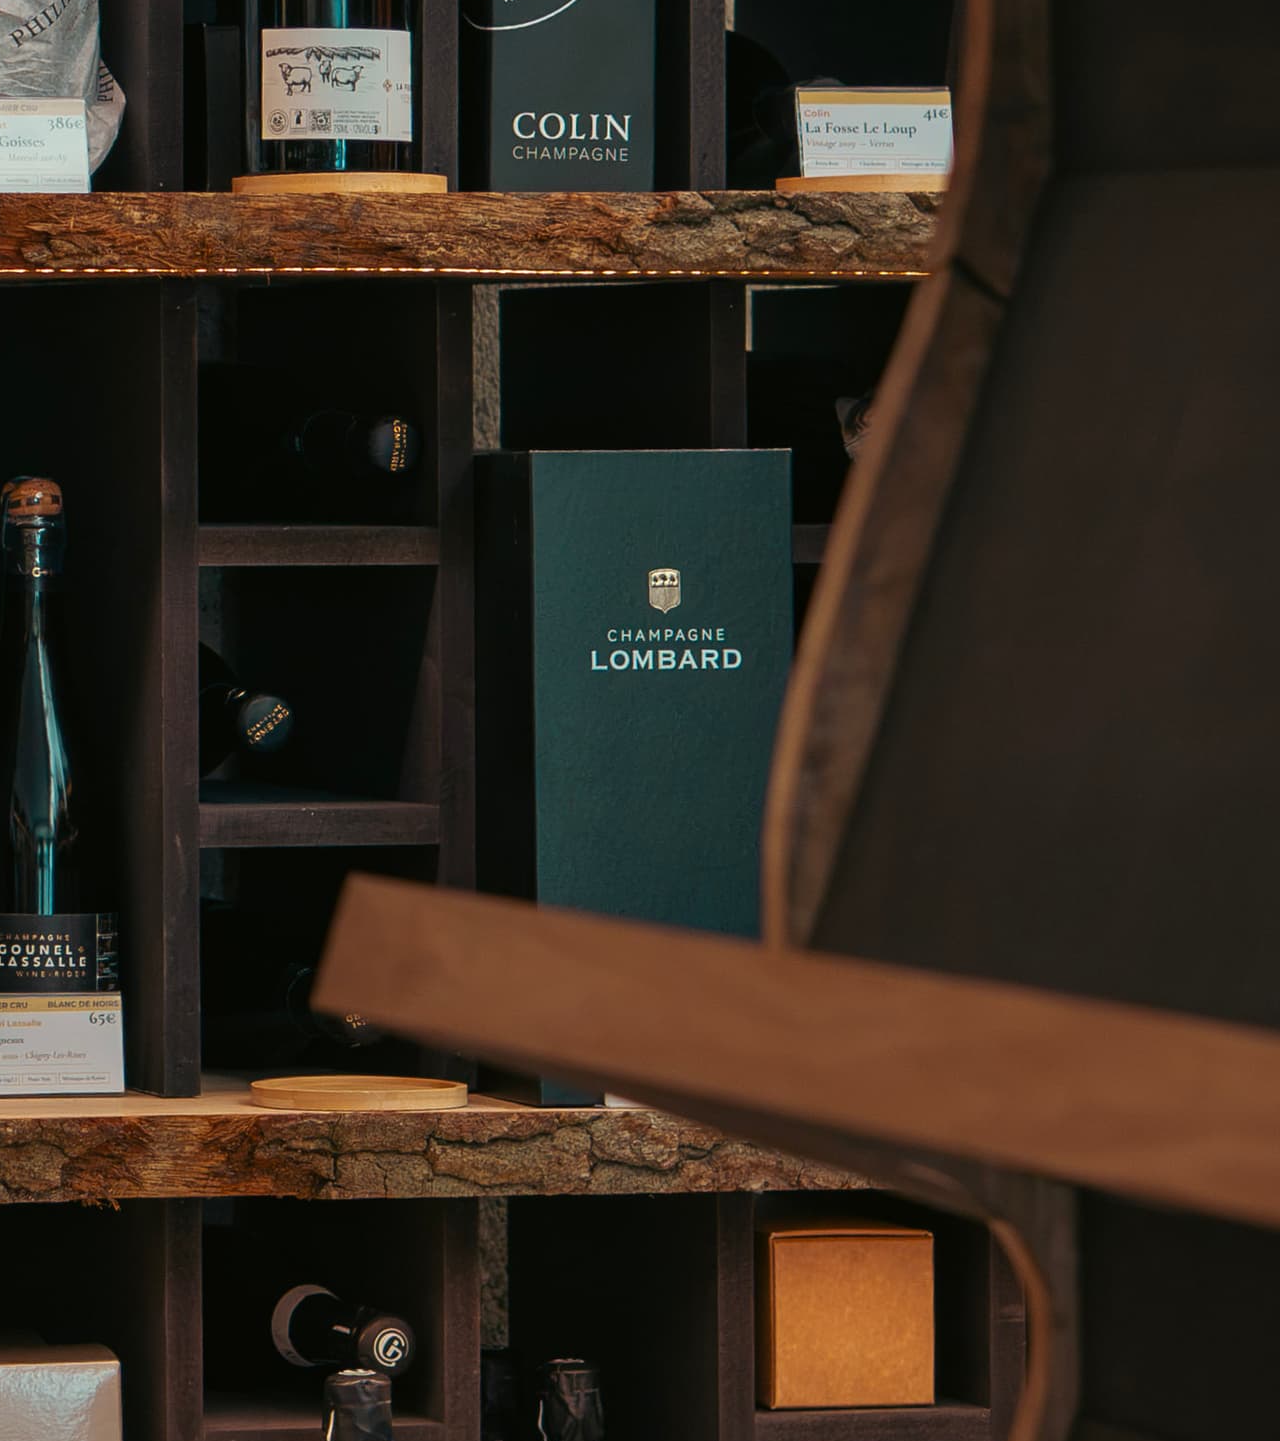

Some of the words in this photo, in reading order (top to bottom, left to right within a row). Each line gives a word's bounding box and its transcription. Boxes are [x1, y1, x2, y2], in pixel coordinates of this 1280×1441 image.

[512, 112, 631, 141] COLIN
[806, 122, 820, 133] La
[825, 122, 859, 133] Fosse
[883, 122, 917, 137] Loup
[512, 146, 628, 162] CHAMPAGNE
[607, 629, 725, 642] CHAMPAGNE
[591, 649, 742, 671] LOMBARD
[89, 1013, 116, 1026] 65€
